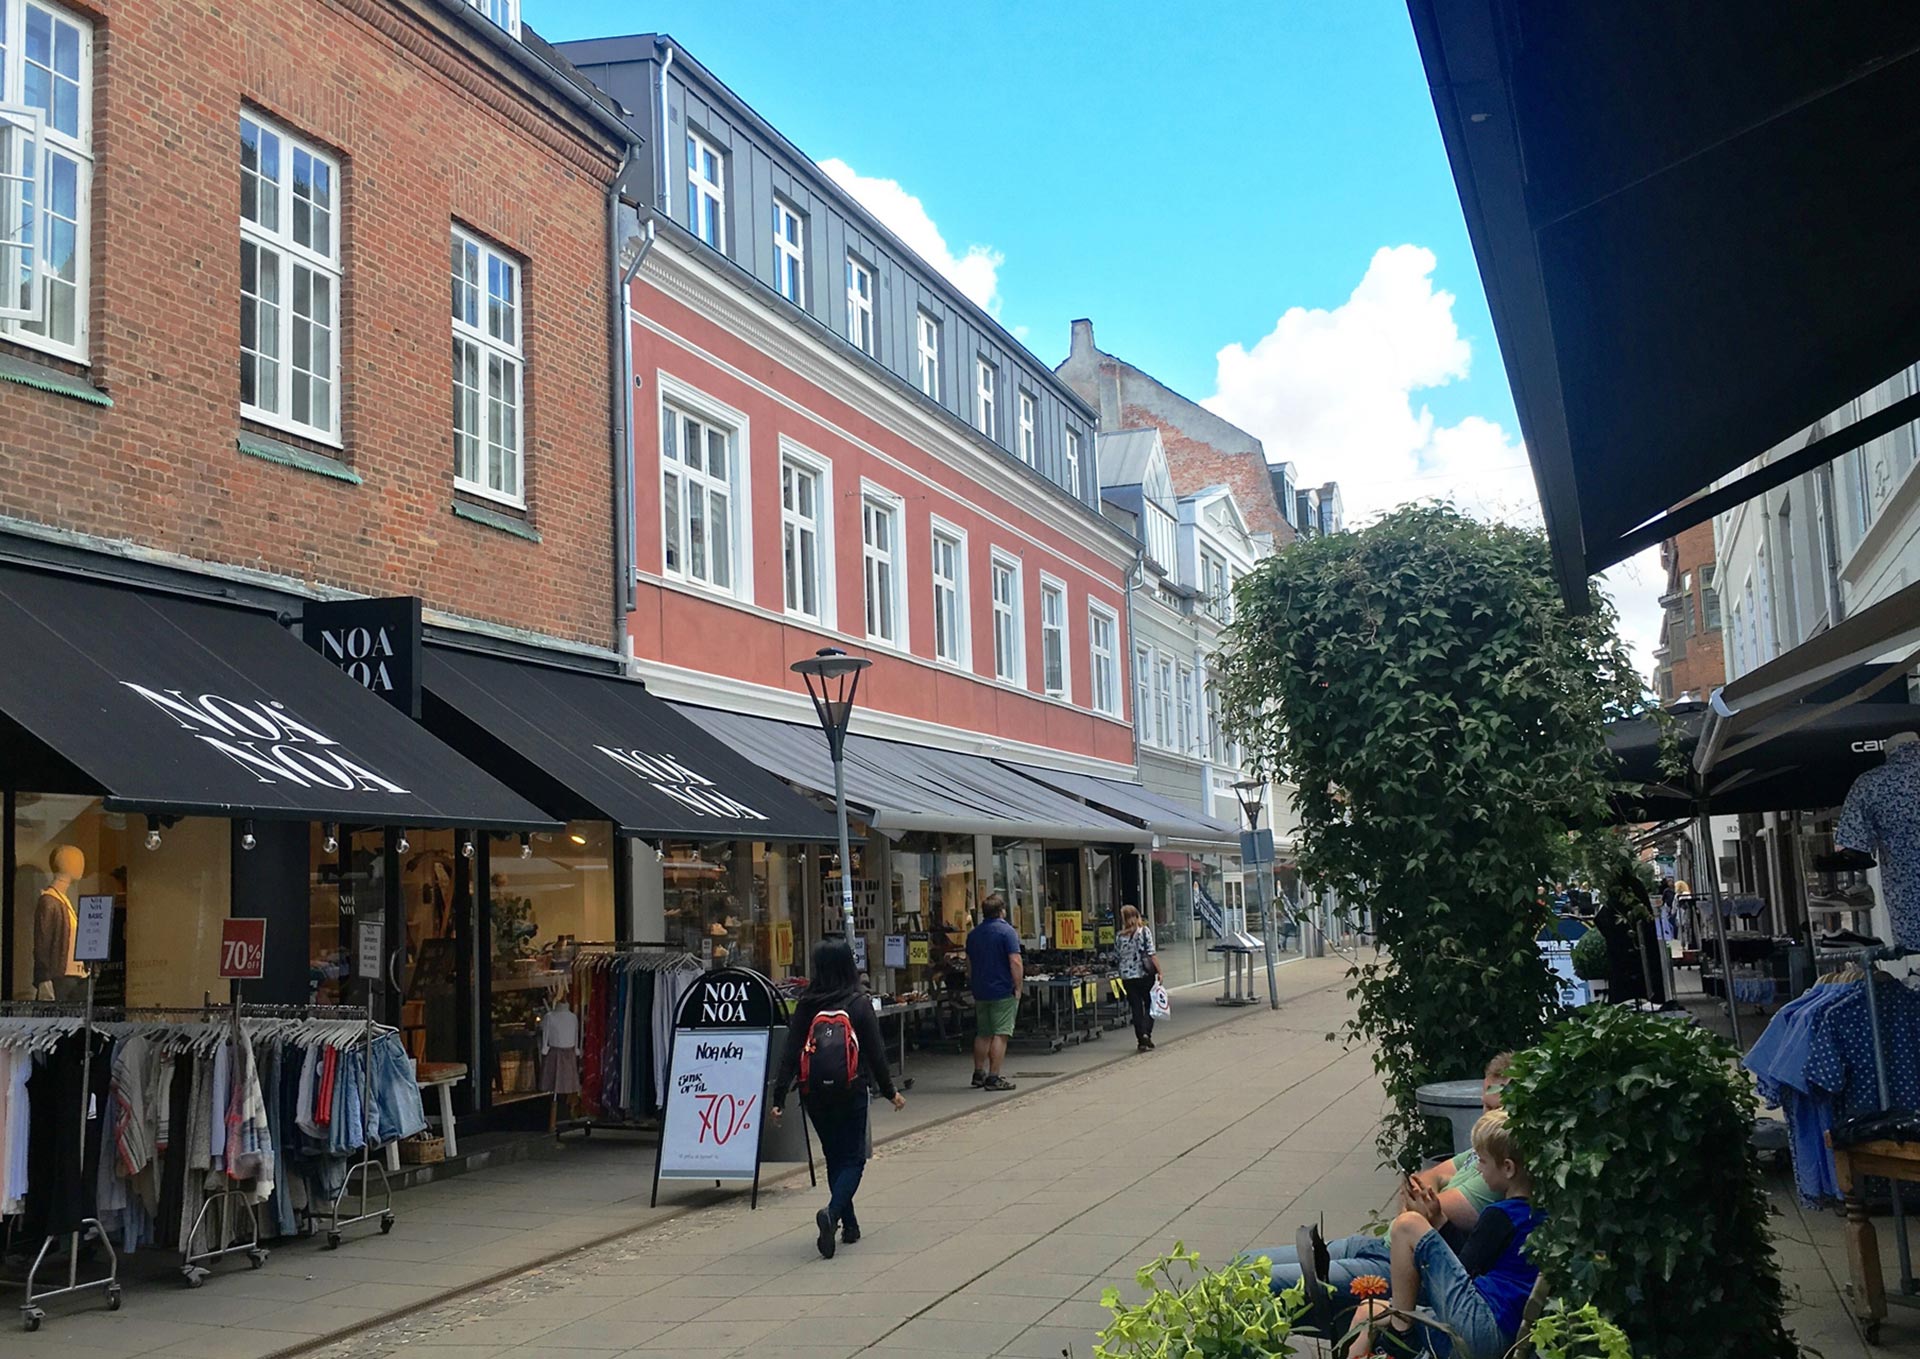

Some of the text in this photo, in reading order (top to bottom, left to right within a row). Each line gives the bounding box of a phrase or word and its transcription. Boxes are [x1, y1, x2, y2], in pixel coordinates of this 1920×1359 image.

[321, 626, 393, 659] NOA
[340, 661, 393, 691] OA
[119, 681, 340, 745] NOA
[195, 735, 411, 794] NOA
[593, 744, 716, 786] NOA
[649, 782, 770, 820] NOA
[223, 940, 262, 970] 70%
[704, 982, 749, 1002] NOA
[701, 1002, 747, 1023] NOA
[695, 1094, 756, 1145] 70%
